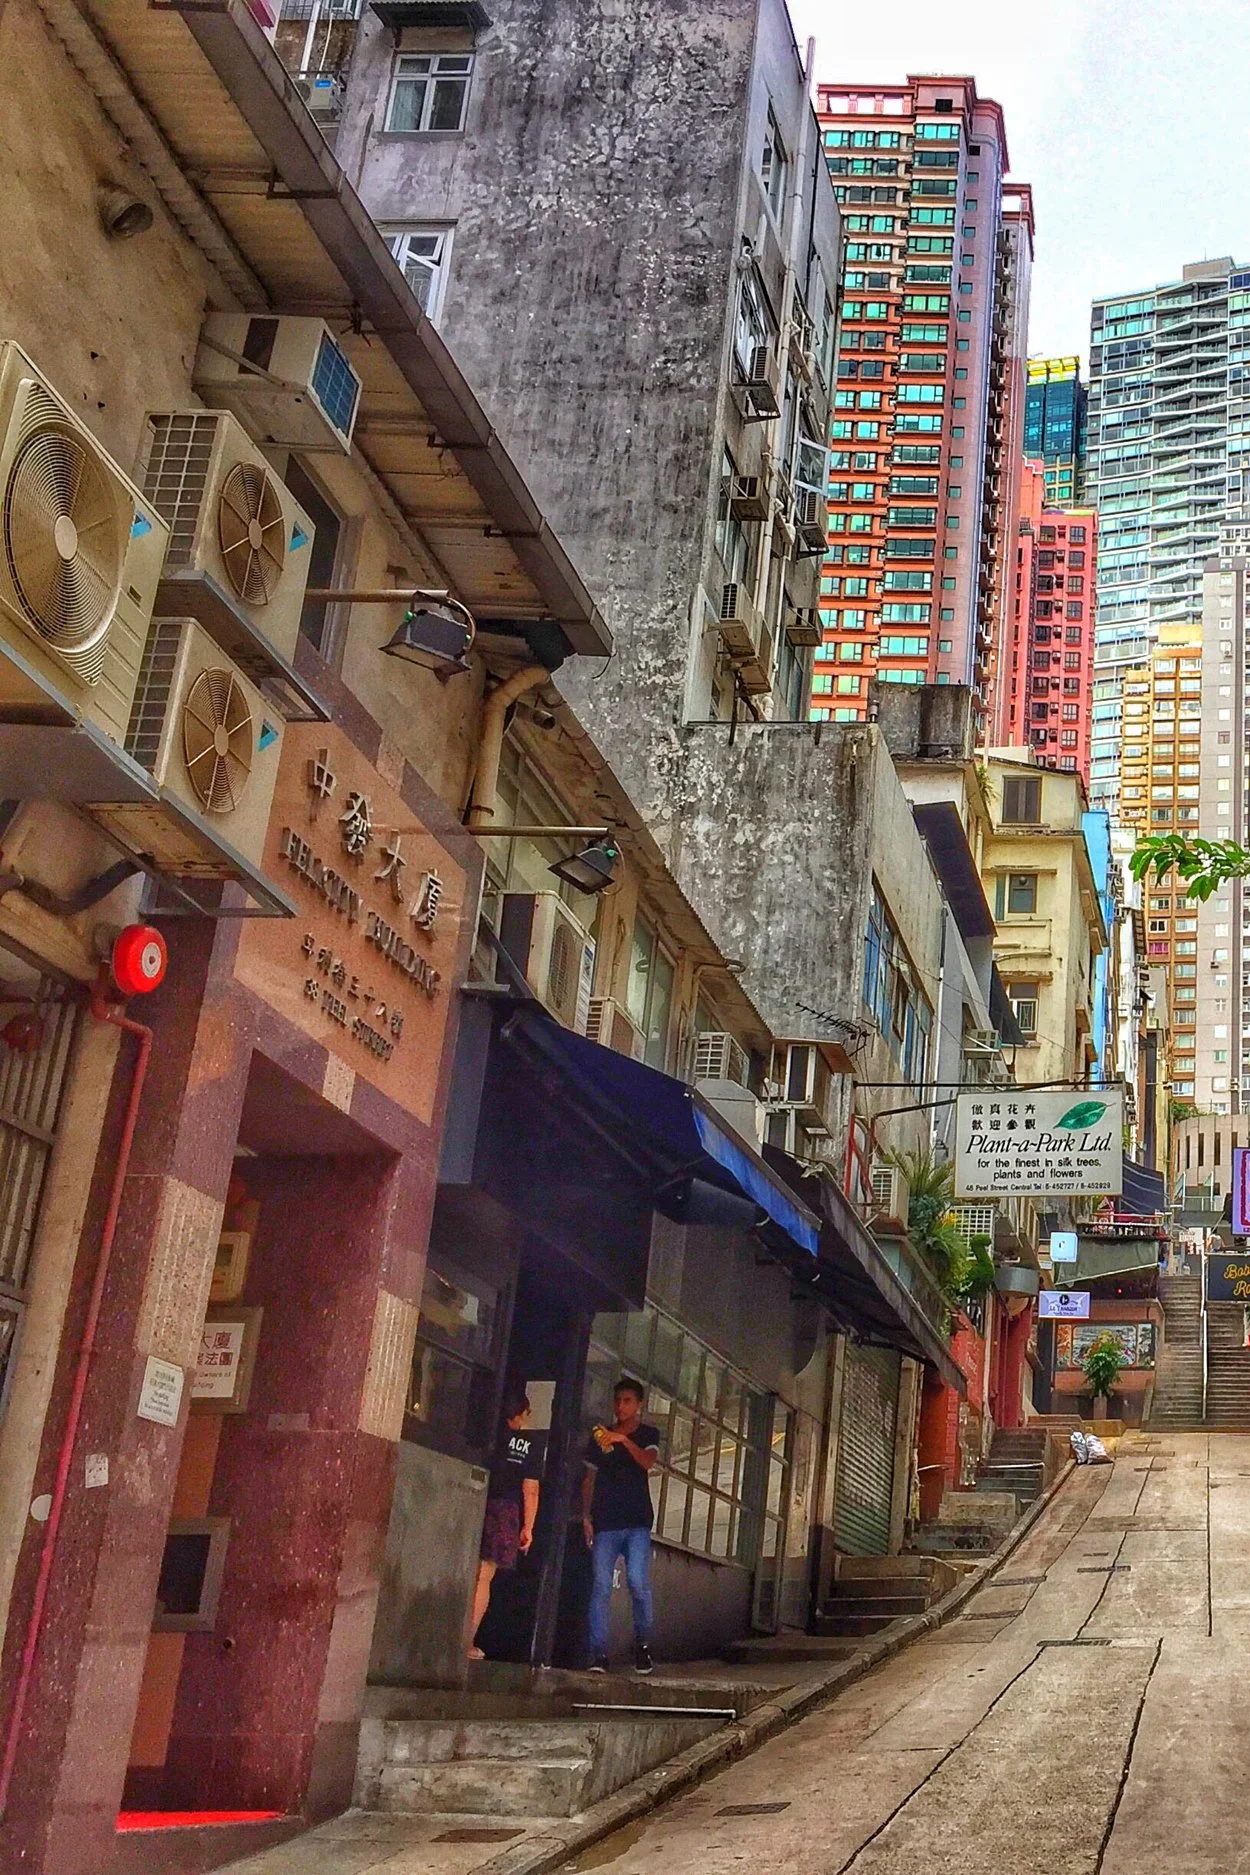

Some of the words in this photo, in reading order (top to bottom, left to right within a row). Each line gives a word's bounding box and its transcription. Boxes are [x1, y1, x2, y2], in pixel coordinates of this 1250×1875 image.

[1078, 1131, 1112, 1152] Ltd.
[977, 1159, 990, 1168] for
[995, 1158, 1010, 1168] the
[1015, 1158, 1040, 1168] finest
[1045, 1158, 1053, 1167] in
[1057, 1157, 1072, 1167] silk
[993, 1170, 1022, 1182] plants
[1027, 1169, 1045, 1179] and
[1050, 1168, 1083, 1178] flowers
[976, 1184, 988, 1192] Peel
[990, 1183, 1008, 1191] Street
[1010, 1183, 1033, 1191] Central
